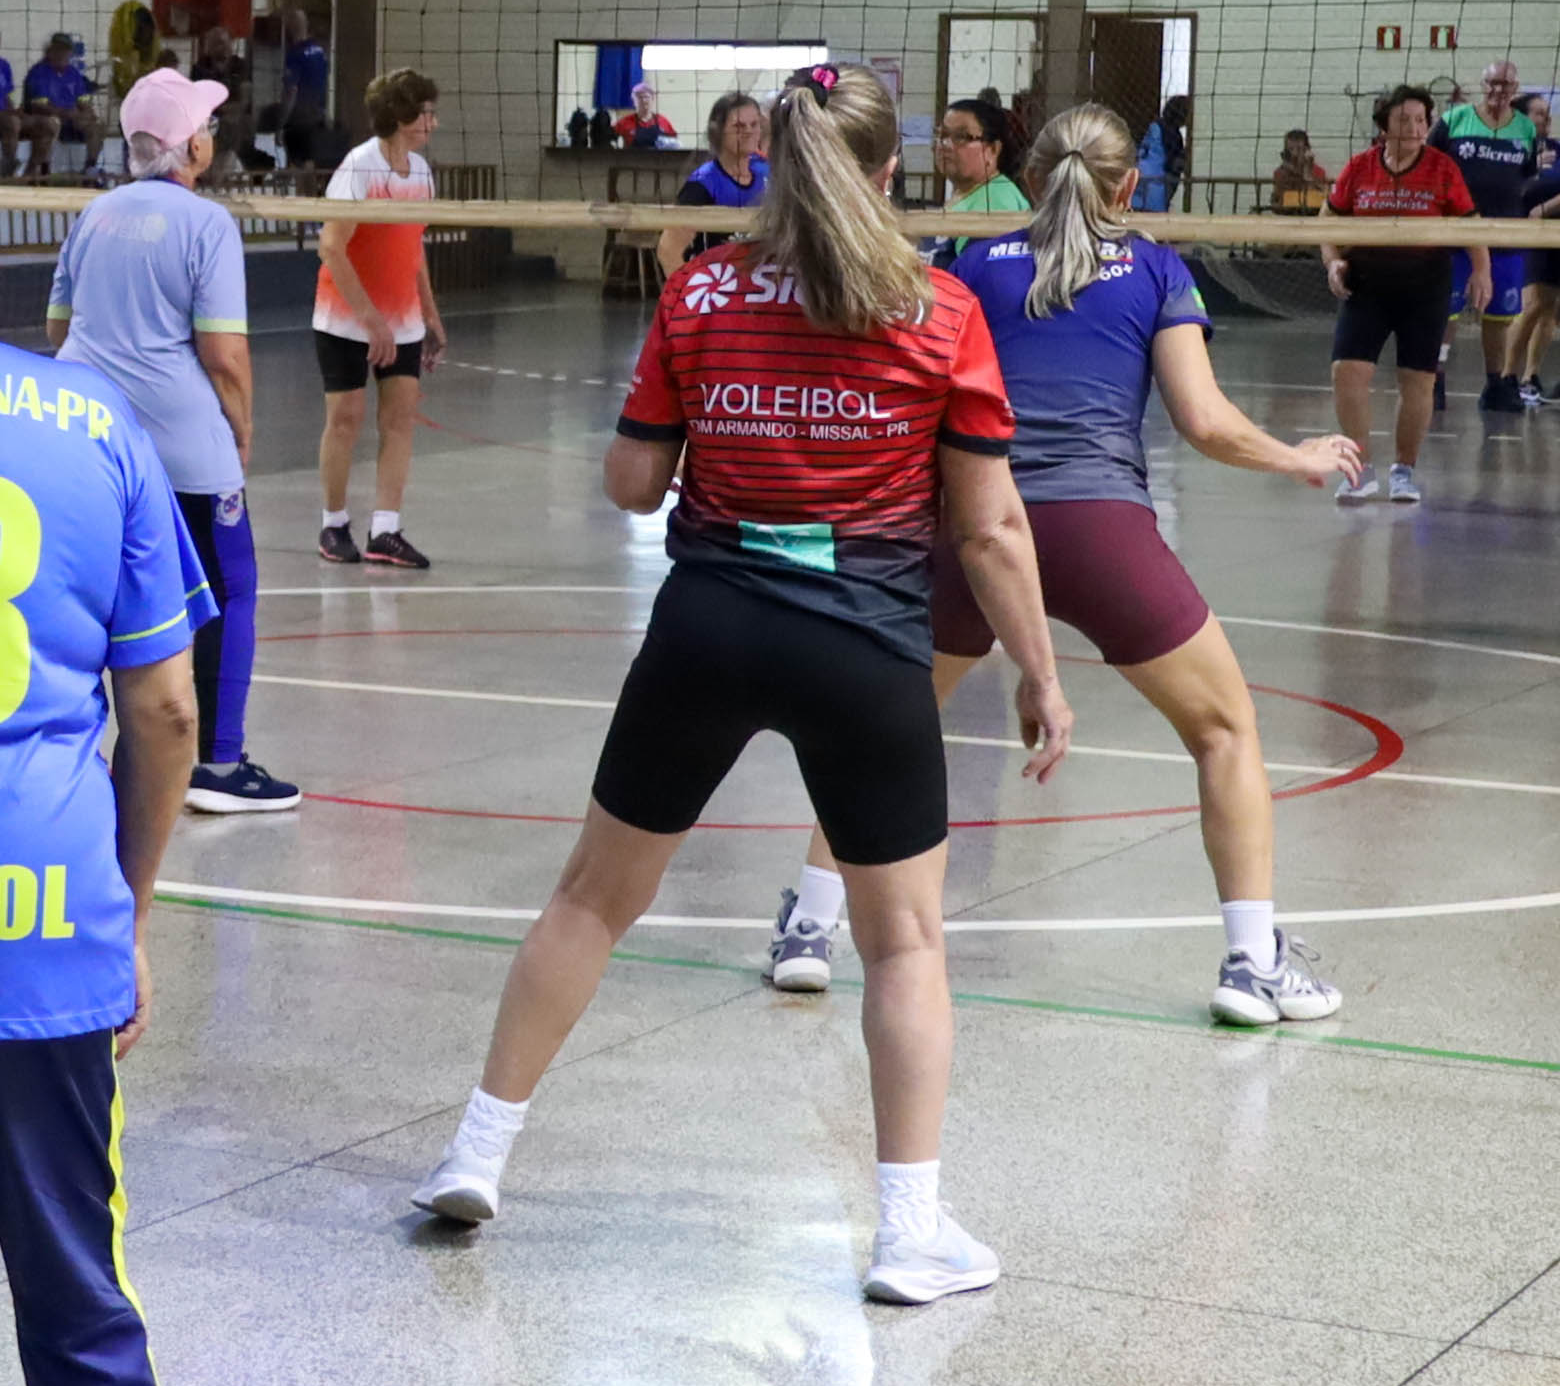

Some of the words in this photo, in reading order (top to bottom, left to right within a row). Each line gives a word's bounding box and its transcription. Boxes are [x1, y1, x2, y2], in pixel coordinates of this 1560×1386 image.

[1477, 144, 1525, 164] Sicredi
[1099, 263, 1134, 282] 60+
[700, 383, 893, 421] VOLEIBOL
[715, 420, 797, 439] ARMANDO
[810, 424, 872, 441] MISSAL
[887, 421, 910, 438] PR
